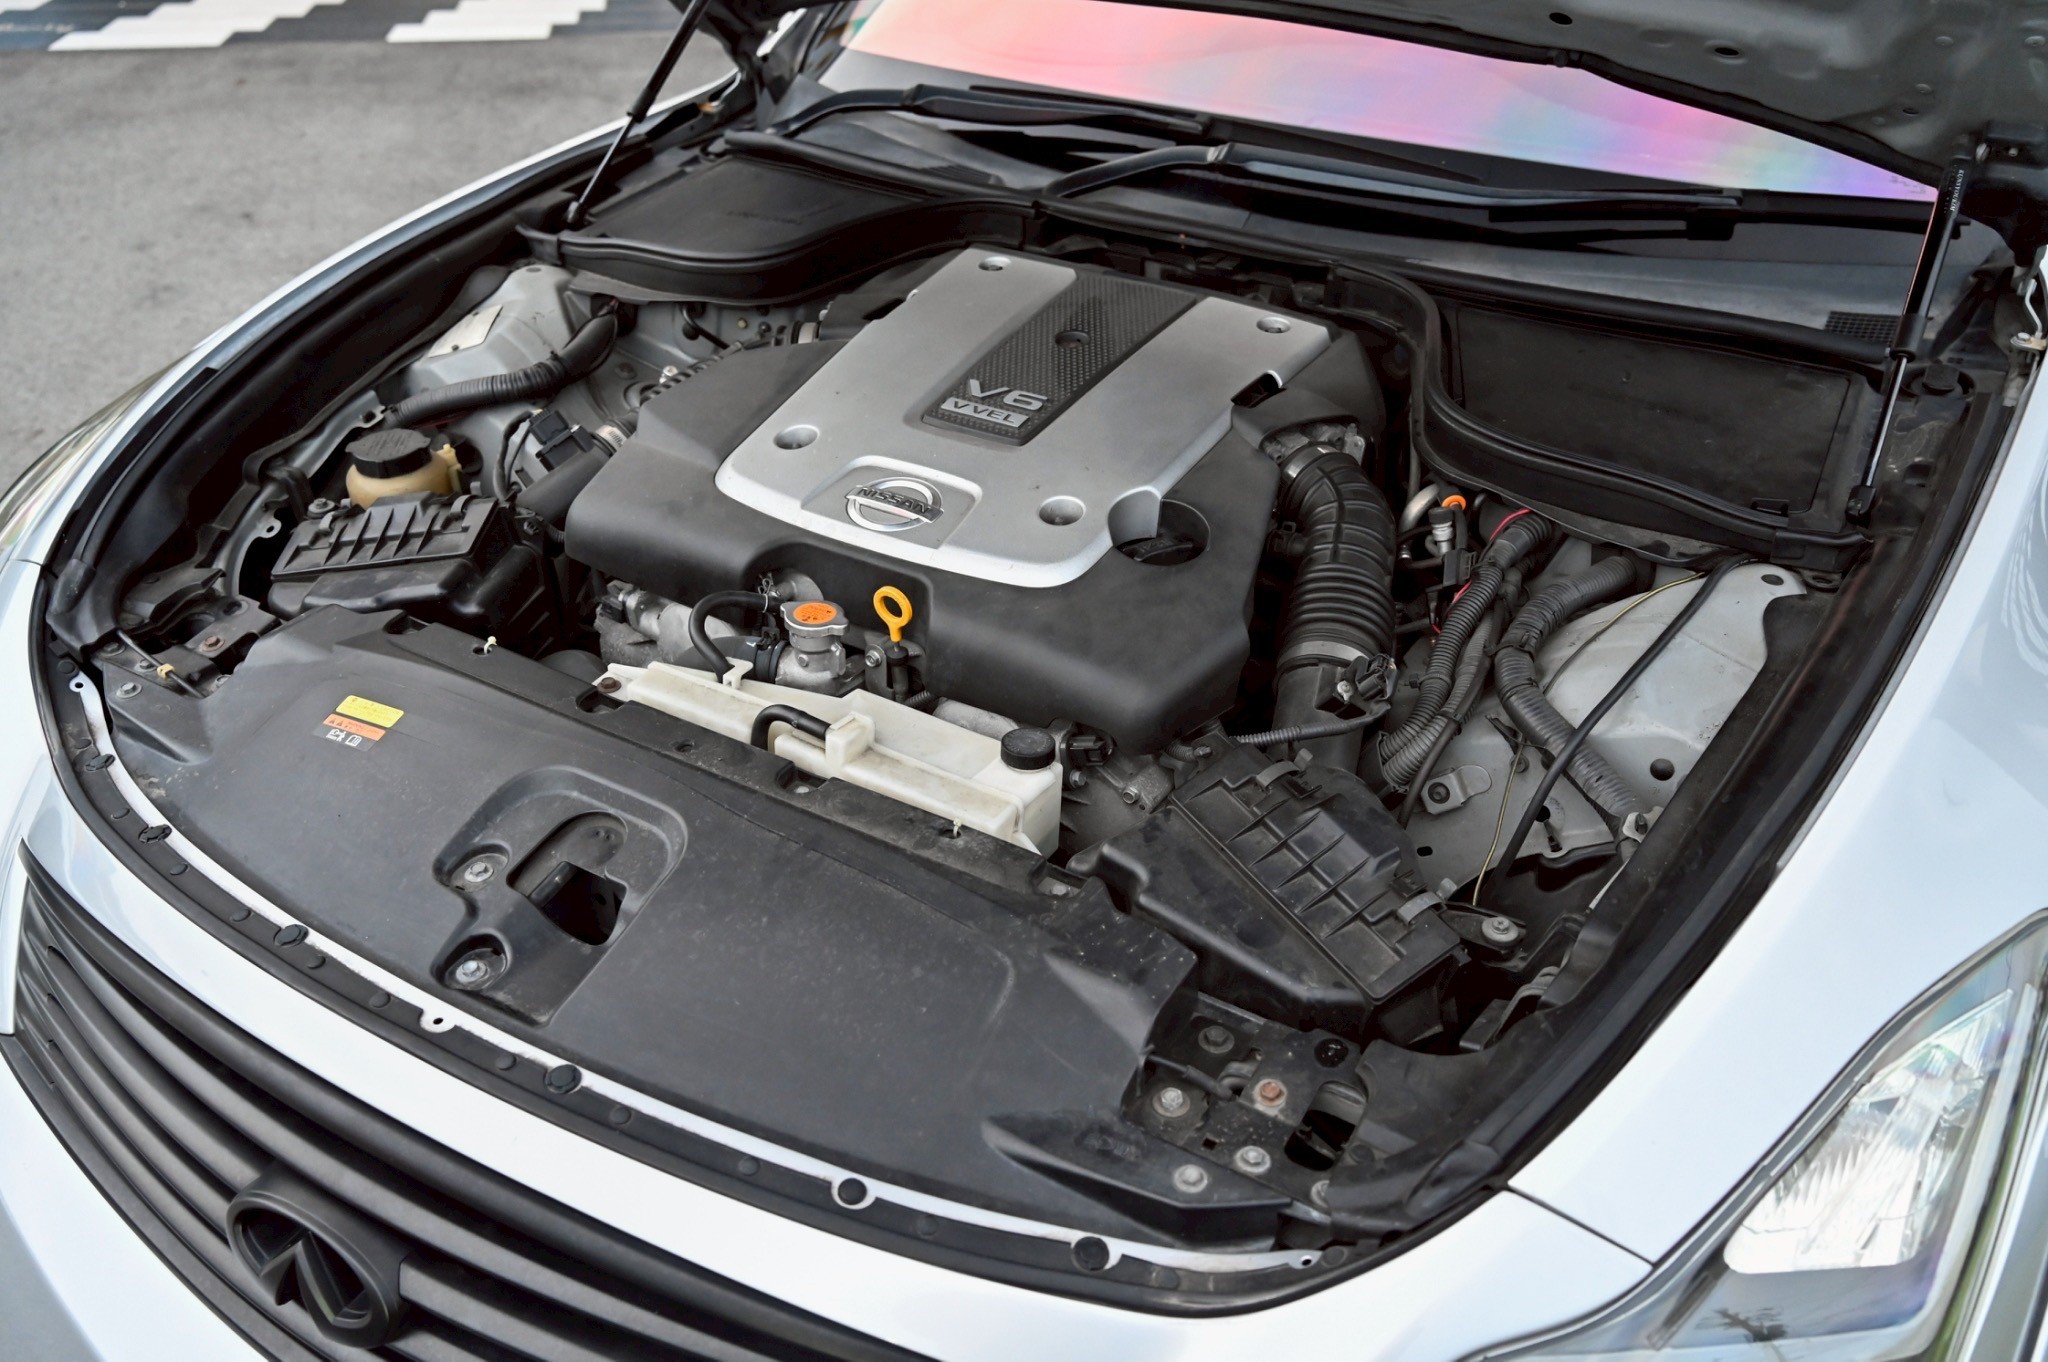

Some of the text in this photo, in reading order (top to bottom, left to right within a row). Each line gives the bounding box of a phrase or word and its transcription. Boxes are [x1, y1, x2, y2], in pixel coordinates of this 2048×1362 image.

[969, 378, 1048, 410] V6
[953, 400, 1015, 424] VVEL
[856, 487, 929, 514] NISSAN
